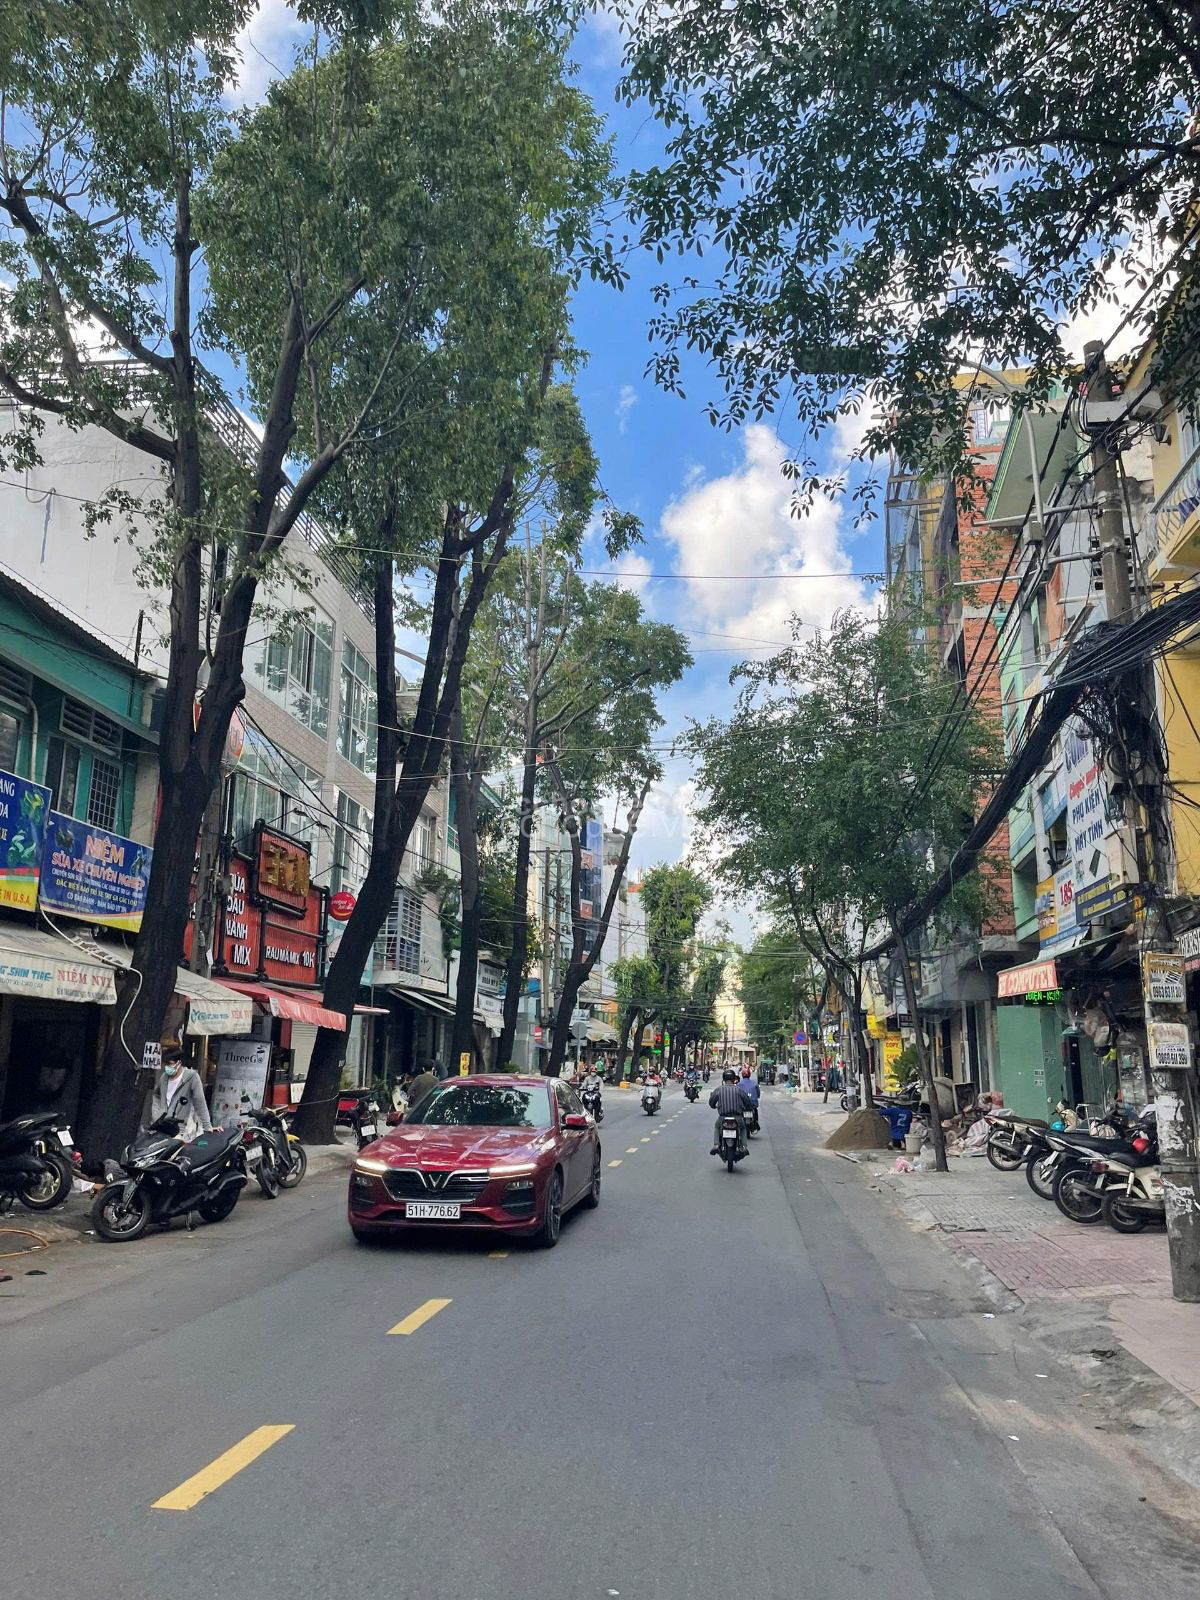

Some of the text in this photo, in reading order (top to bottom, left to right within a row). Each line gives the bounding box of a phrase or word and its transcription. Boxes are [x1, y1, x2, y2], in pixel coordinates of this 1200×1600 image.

[85, 835, 125, 867] NIỆM
[234, 944, 251, 966] MIX
[265, 945, 280, 960] RAU
[57, 968, 87, 985] NIỆM
[407, 1204, 459, 1218] 51H-776.62
